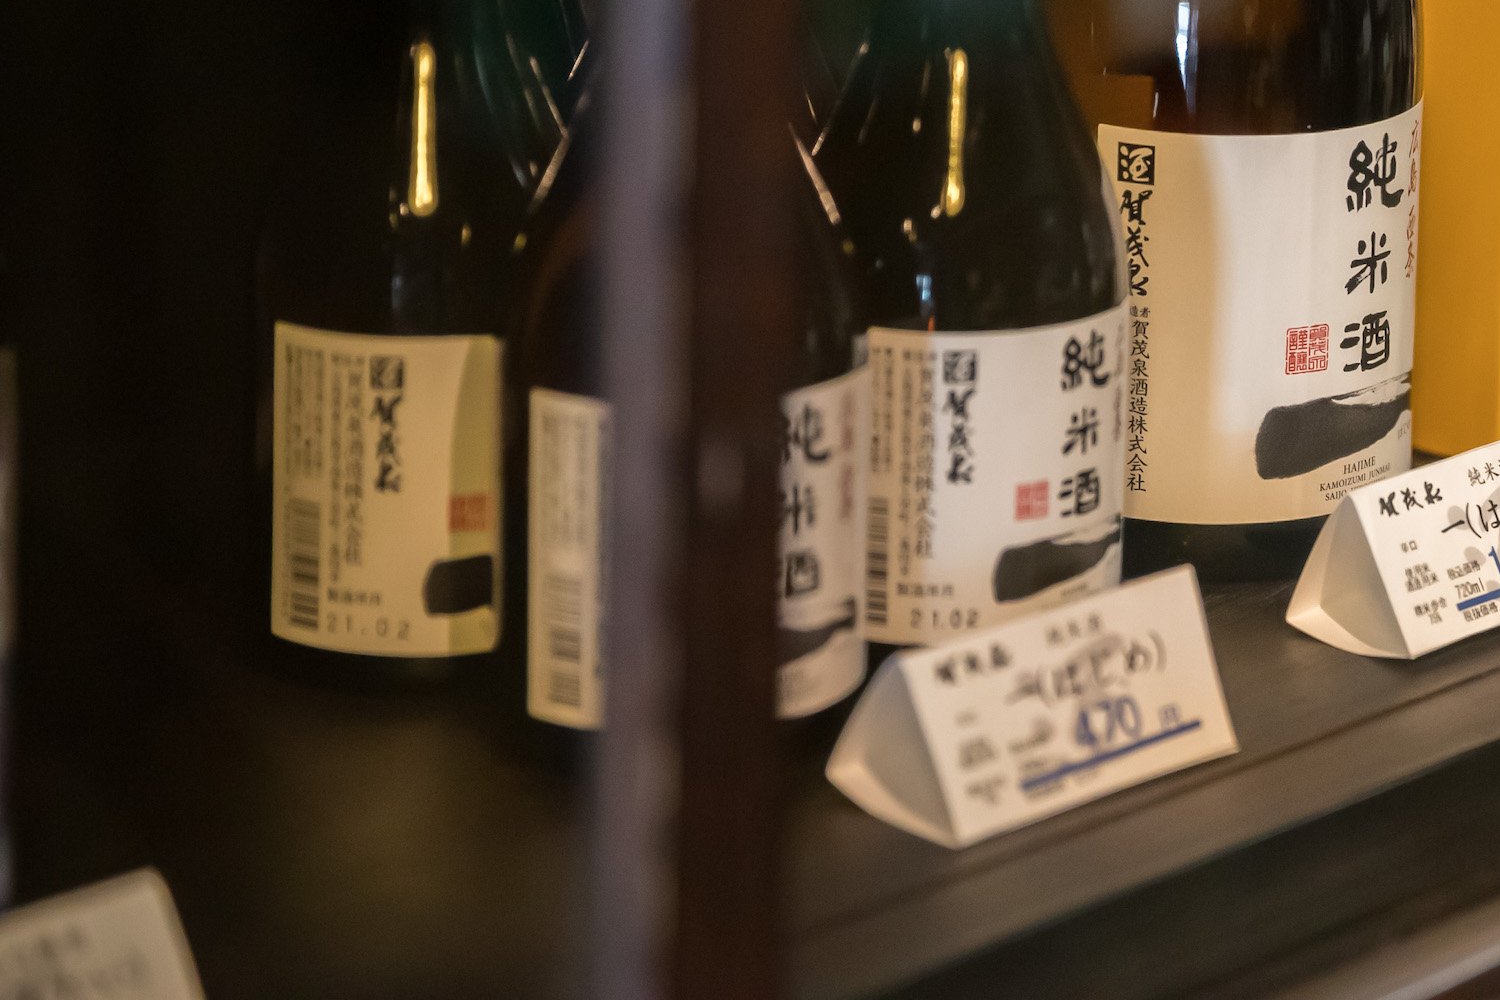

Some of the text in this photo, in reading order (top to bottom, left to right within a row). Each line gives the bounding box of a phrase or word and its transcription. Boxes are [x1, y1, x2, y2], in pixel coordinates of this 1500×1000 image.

[1341, 132, 1404, 373] 純米酒
[1057, 327, 1110, 519] 純米酒
[1126, 320, 1150, 492] 賀茂泉酒造株式会社
[1319, 473, 1366, 492] KAMOIZUMI
[1343, 456, 1376, 474] HAJIME
